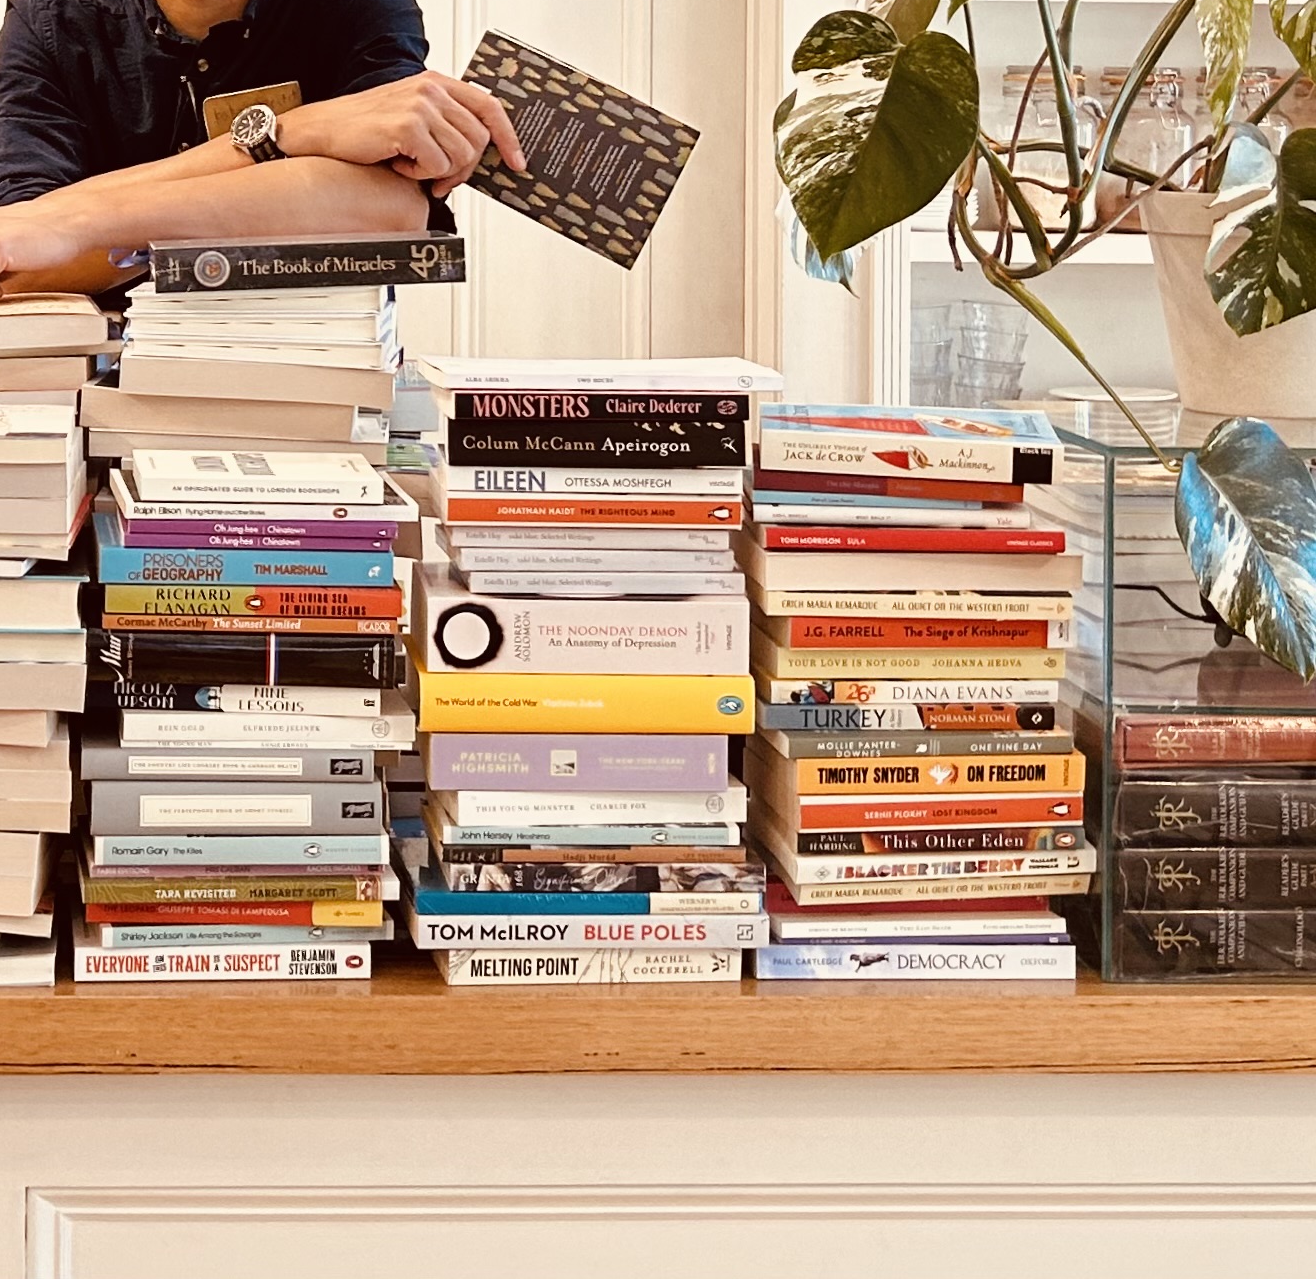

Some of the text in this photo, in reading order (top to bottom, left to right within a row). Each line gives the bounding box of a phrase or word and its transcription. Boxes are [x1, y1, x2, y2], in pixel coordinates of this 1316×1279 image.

[239, 255, 395, 276] The Book of Miracles
[473, 395, 589, 417] MONSTERS
[606, 399, 702, 414] Claire Dederer
[463, 436, 595, 451] Colum McCann
[601, 438, 691, 456] Apeirogon
[784, 450, 864, 463] JACK de CROW
[939, 458, 989, 471] Mackinnon
[474, 470, 546, 492] EILEEN
[565, 477, 672, 488] OTTESSA MOSHFEGH
[128, 569, 223, 582] OF GEOGRAPHY
[254, 564, 328, 576] TIM MARSHALL
[156, 589, 231, 600] RICHARD
[145, 603, 230, 615] FLANAGAN
[117, 617, 207, 630] Cormac McCarthy
[212, 618, 301, 630] The Sunset Limited
[514, 613, 522, 659] ANDREW
[523, 610, 531, 662] SOLOMON
[538, 625, 688, 637] THE NOONDAY DEMON
[804, 626, 884, 637] J.G. FARRELL
[904, 626, 1029, 641] The Siege of Krishnapur
[548, 638, 676, 650] An Anatomy of Depression
[114, 683, 177, 695] NICOLA
[254, 687, 289, 699] NINE
[846, 684, 876, 701] 26a
[893, 685, 1013, 700] DIANA EVANS
[118, 696, 174, 709] UPSON
[239, 699, 304, 712] LESSONS
[435, 698, 449, 706] The
[477, 698, 485, 706] of
[503, 699, 521, 707] Cold
[524, 699, 537, 707] War
[800, 708, 887, 728] TURKEY
[929, 714, 1011, 723] NORMAN STONE
[817, 767, 919, 784] TIMOTHY SNYDER
[967, 764, 1046, 782] ON FREEDOM
[155, 889, 236, 899] TARA REVISITED
[250, 888, 337, 898] MARGARET SCOTT
[428, 924, 568, 940] TOM McILROY
[585, 925, 707, 941] BLUE POLES
[291, 950, 335, 961] BENJAMIN
[645, 955, 692, 964] RACHEL
[898, 954, 1005, 970] DEMOCRACY
[86, 954, 280, 973] EVERYONE TRAIN SUSPECT
[289, 962, 337, 975] STEVENSON
[471, 958, 579, 977] MELTING POINT
[634, 966, 703, 975] COCKERELL
